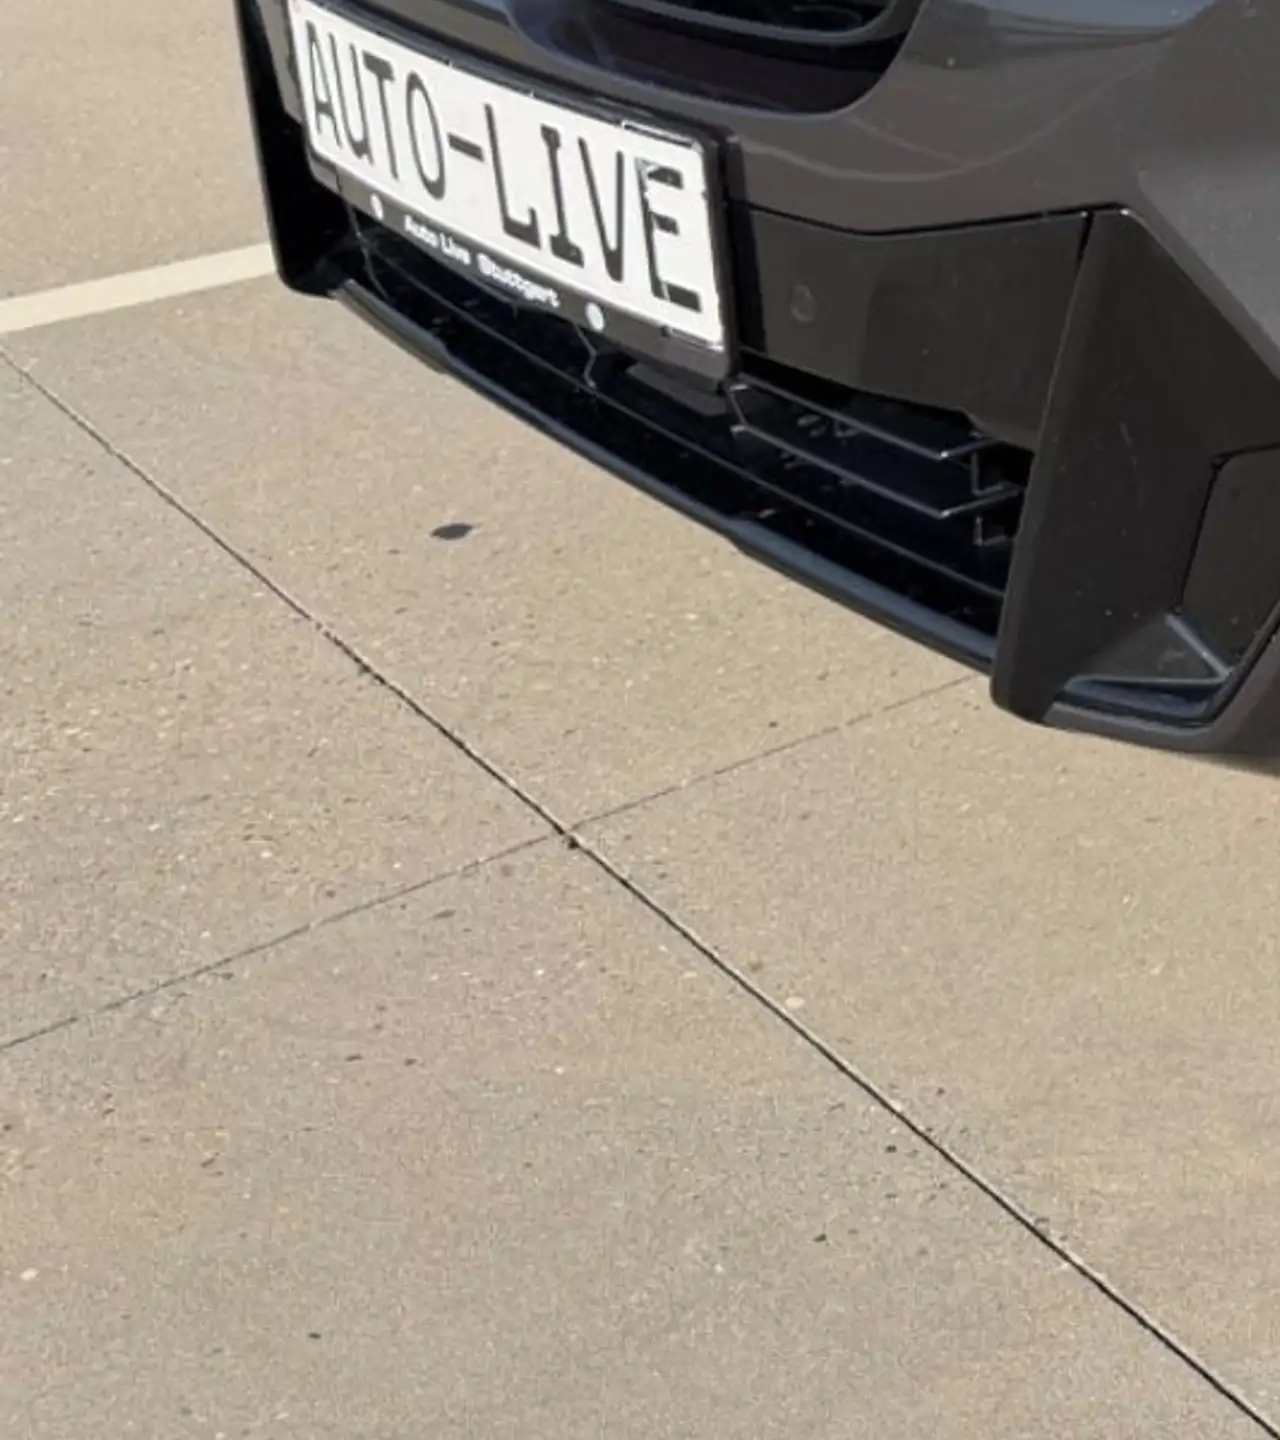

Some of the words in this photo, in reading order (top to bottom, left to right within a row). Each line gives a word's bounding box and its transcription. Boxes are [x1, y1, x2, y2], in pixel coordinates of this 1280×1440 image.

[305, 19, 703, 313] AUTO-LIVE
[403, 213, 438, 247] Auto
[439, 231, 472, 265] Live
